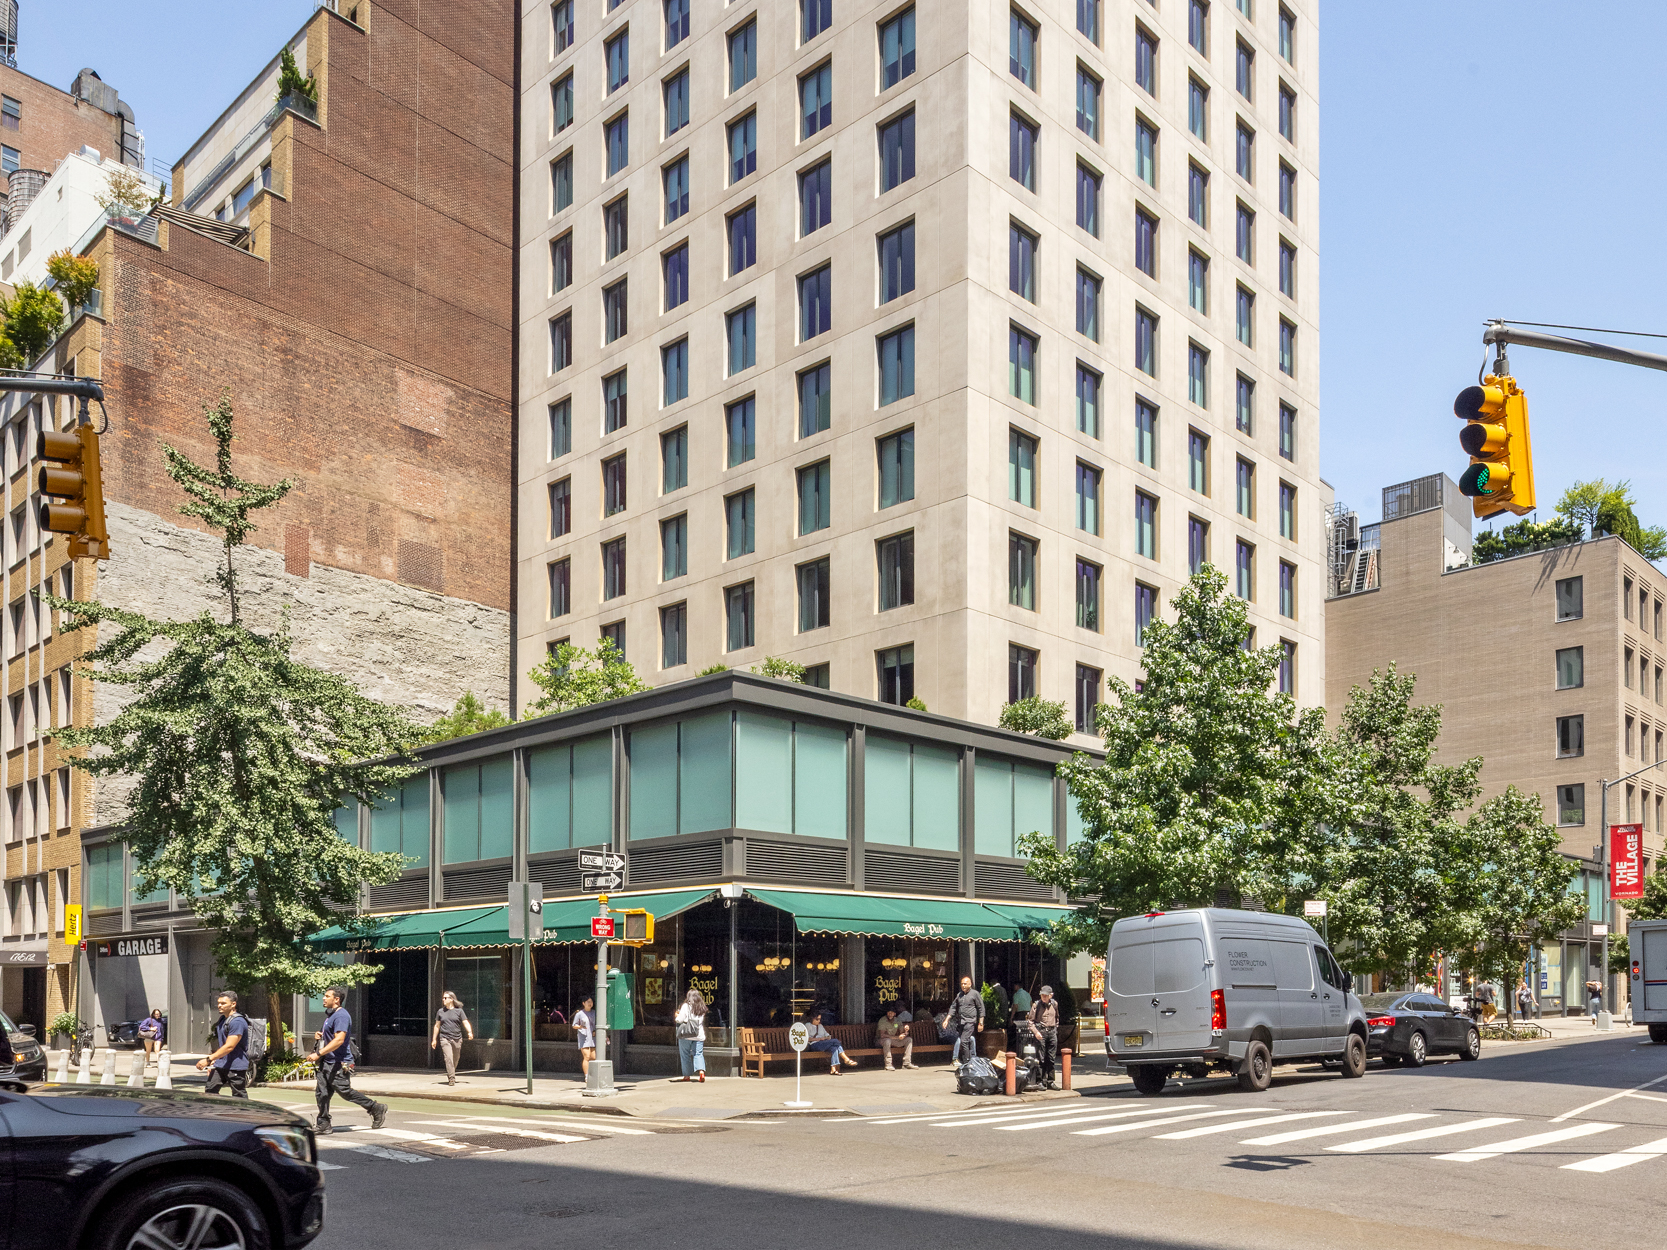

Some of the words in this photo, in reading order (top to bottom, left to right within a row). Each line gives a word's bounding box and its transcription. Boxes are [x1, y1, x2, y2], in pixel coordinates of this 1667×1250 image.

[583, 855, 598, 865] ONE
[605, 858, 619, 867] WAY
[1627, 835, 1638, 885] VILLAGE
[1616, 861, 1627, 886] THE
[586, 878, 598, 886] ONE
[604, 877, 617, 885] WAY
[68, 913, 77, 936] Hertz
[903, 923, 925, 934] Bagel
[928, 924, 943, 935] Pub
[543, 930, 557, 941] Pub
[118, 938, 162, 957] GARAGE
[689, 976, 718, 993] Bagel
[874, 975, 902, 990] Bagel
[879, 988, 899, 1004] Pub
[791, 1028, 807, 1038] Bagel
[793, 1037, 805, 1046] Pub
